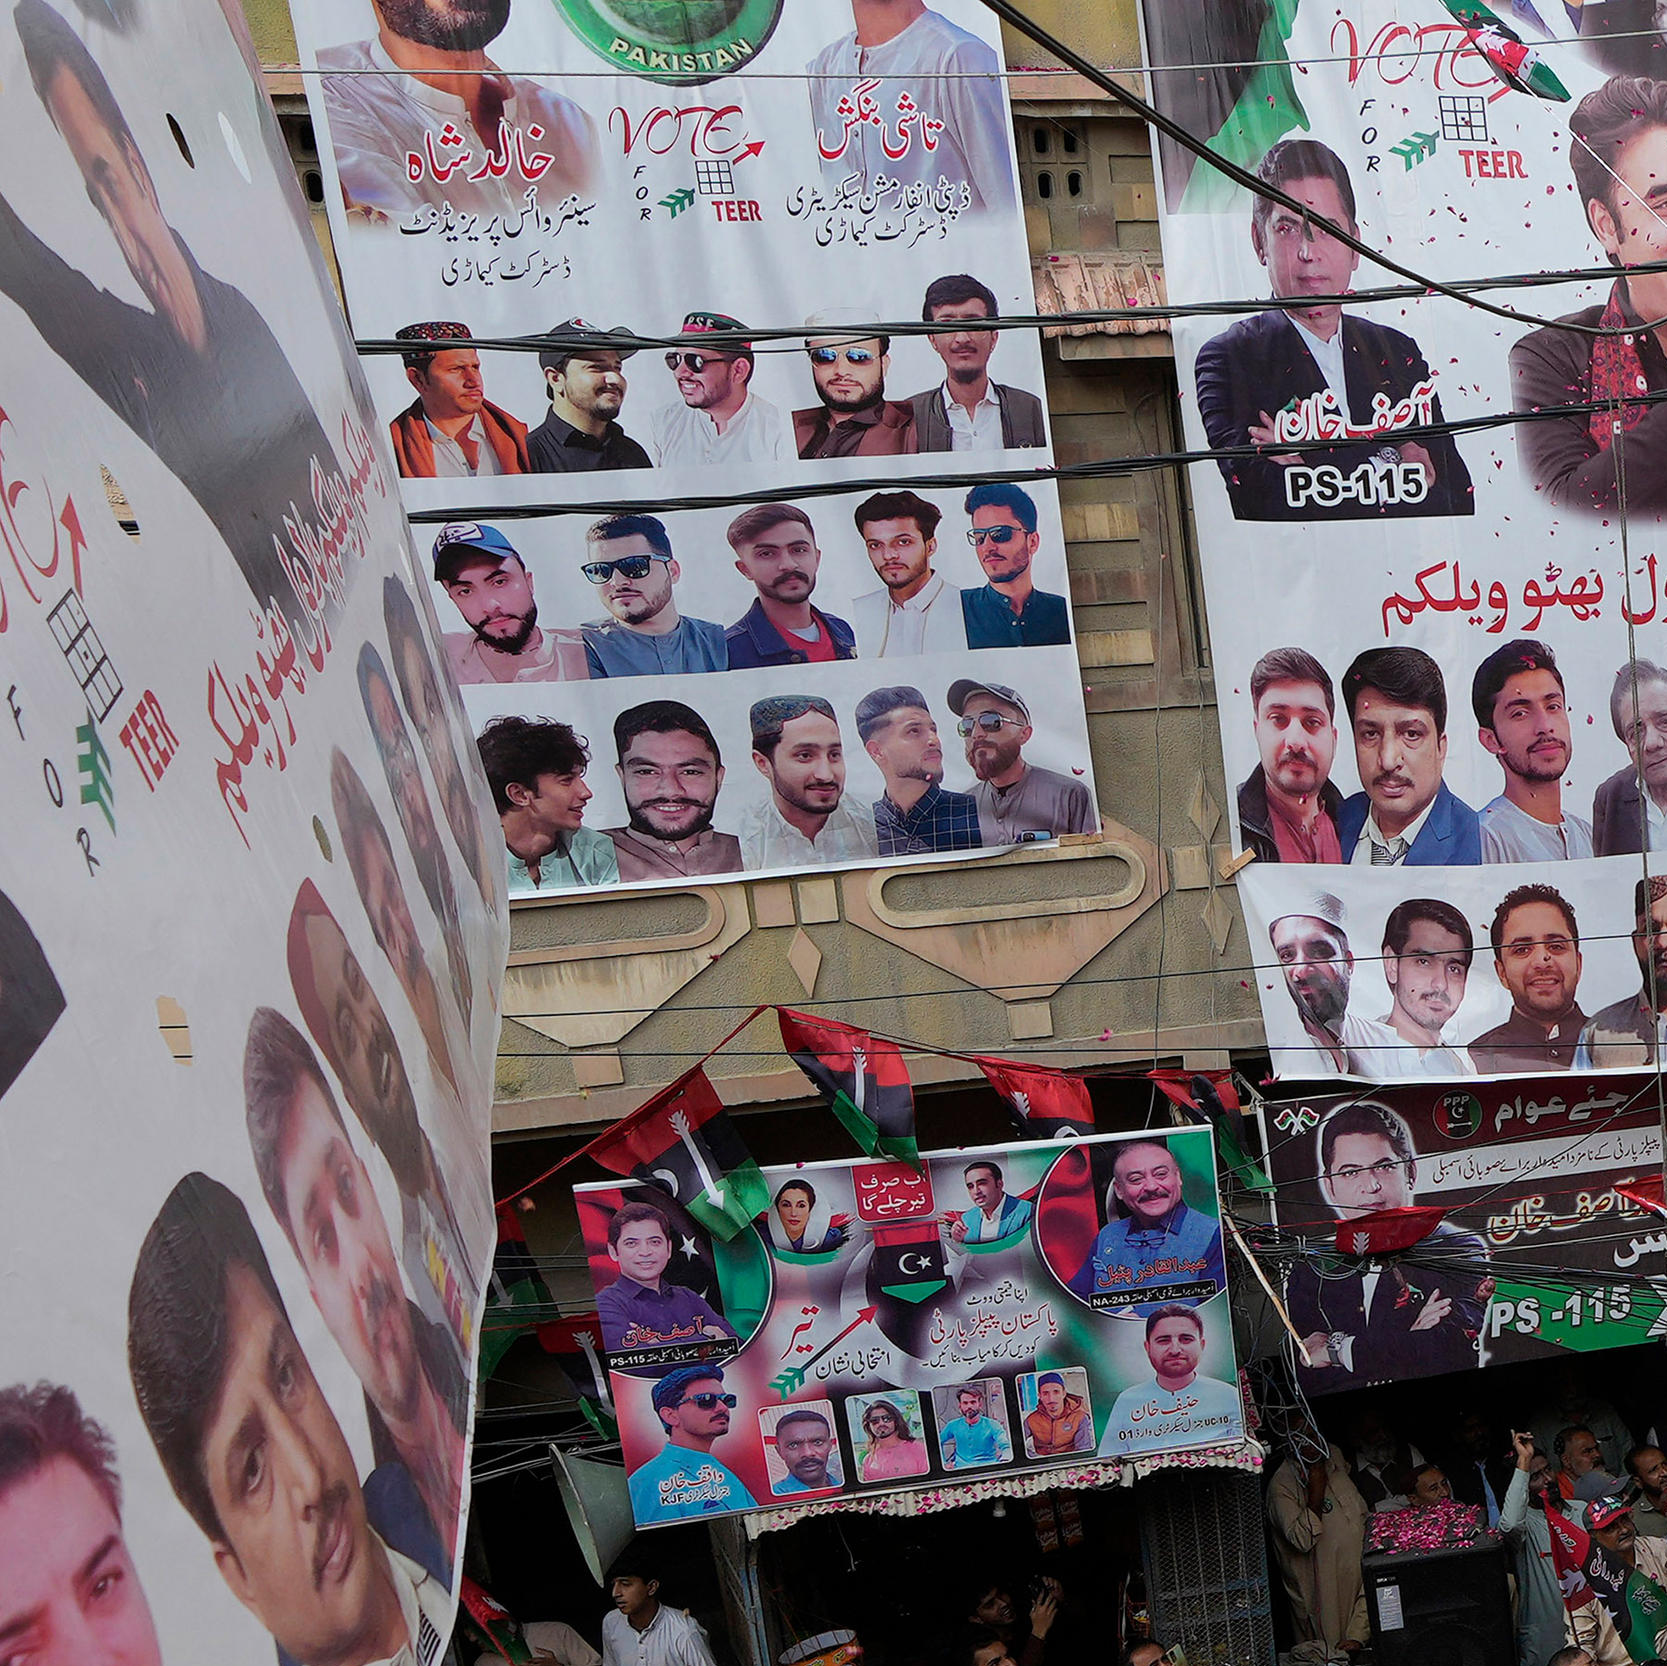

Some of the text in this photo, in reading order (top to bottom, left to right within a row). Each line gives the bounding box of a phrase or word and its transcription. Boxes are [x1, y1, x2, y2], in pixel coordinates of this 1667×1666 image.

[609, 36, 754, 73] PAKISTAN
[609, 105, 750, 159] VOTE
[817, 78, 884, 162] بنگش
[406, 117, 555, 184] خالد شاہ
[1458, 150, 1528, 179] TEER
[502, 187, 552, 239] وائس
[711, 199, 763, 222] TEER
[934, 176, 971, 221] ڈپٹی
[815, 208, 948, 249] ڈسٹرکٹ کیماڑی
[441, 250, 572, 288] ڈسٹرکٹ کیماڑی
[1275, 388, 1347, 444] خان
[1285, 463, 1429, 508] PS-115
[1380, 560, 1509, 638] ویلکم
[1520, 561, 1606, 632] بھٹو
[118, 689, 179, 792] TEER
[1443, 1095, 1470, 1107] PPP
[1494, 1094, 1567, 1134] عوام
[860, 1174, 900, 1194] صرف
[907, 1192, 927, 1212] تیر
[862, 1195, 878, 1211] گا
[1093, 1295, 1131, 1307] NA-243
[1491, 1297, 1541, 1338] PS
[621, 1322, 659, 1348] خان
[929, 1308, 967, 1350] پارٹی
[1001, 1304, 1059, 1338] پاکستان
[610, 1354, 646, 1367] PS-115
[1130, 1400, 1160, 1422] خان
[1118, 1429, 1133, 1441] 01
[659, 1471, 687, 1493] خان
[661, 1493, 685, 1505] KJF
